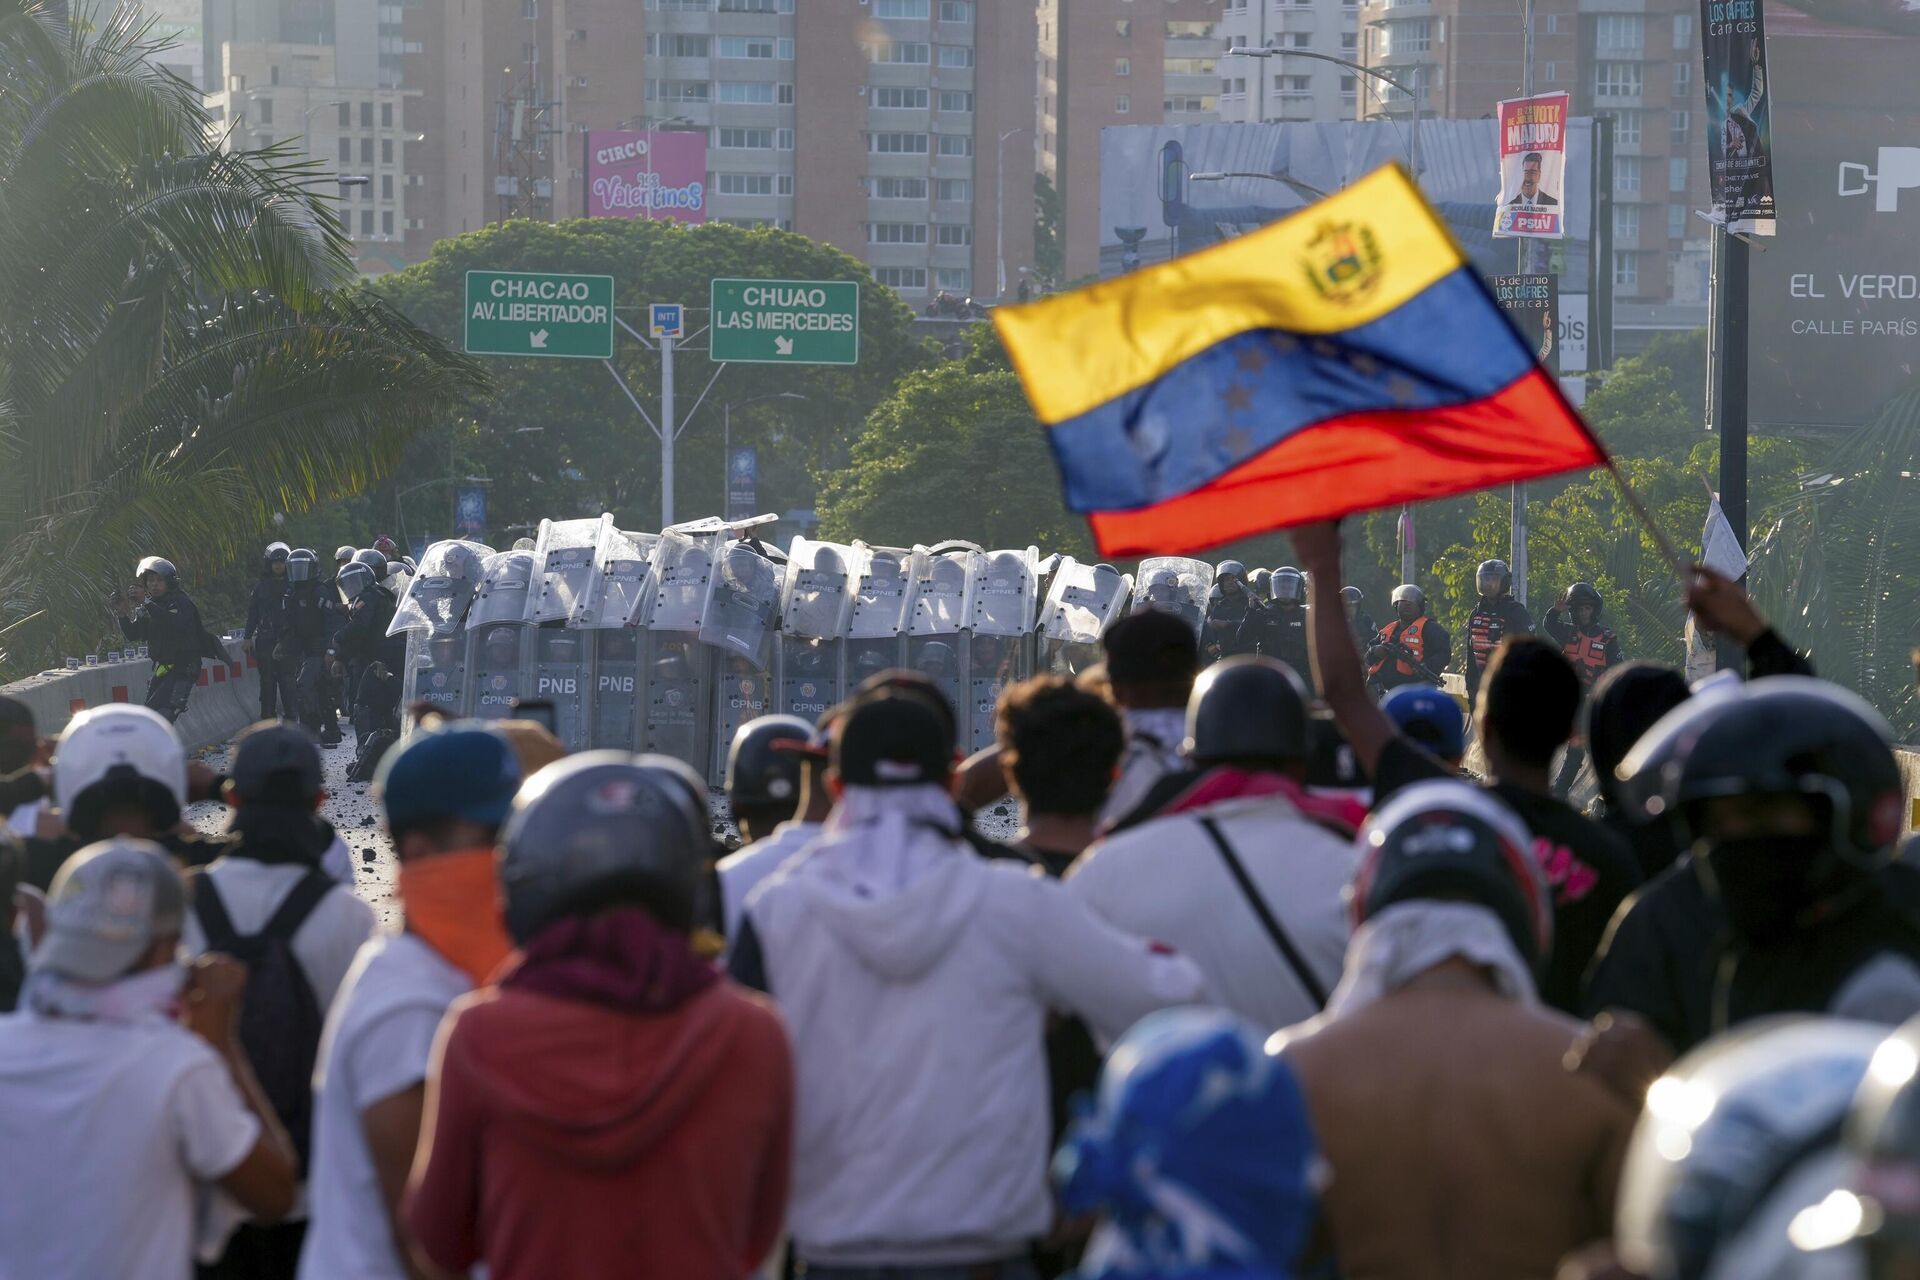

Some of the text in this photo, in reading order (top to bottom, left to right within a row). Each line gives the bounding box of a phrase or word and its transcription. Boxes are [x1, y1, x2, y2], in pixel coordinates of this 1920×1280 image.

[1710, 4, 1724, 22] LOS
[1507, 123, 1559, 147] MADURO
[597, 139, 648, 165] CIRCO
[593, 175, 703, 211] Valentinos
[1494, 275, 1548, 287] 15 de junio
[1790, 274, 1920, 299] EL VERD
[490, 279, 590, 301] CHACAO
[743, 287, 826, 308] CHUAO
[1496, 285, 1548, 300] LOS CAFRES
[472, 302, 607, 324] AV. LIBERTADOR
[658, 312, 676, 321] INTT
[717, 311, 854, 332] LAS MERCEDES
[1791, 317, 1917, 336] CALLE PARÍS
[553, 562, 585, 572] CPNB
[605, 575, 638, 583] CPNB
[667, 578, 700, 586] CPNB
[803, 584, 836, 593] CPNB
[538, 678, 577, 694] PNB
[599, 676, 634, 692] PNB
[424, 693, 453, 701] CPNB
[482, 695, 513, 705] CPNB
[730, 699, 763, 710] CPNB
[792, 703, 825, 713] CPNB
